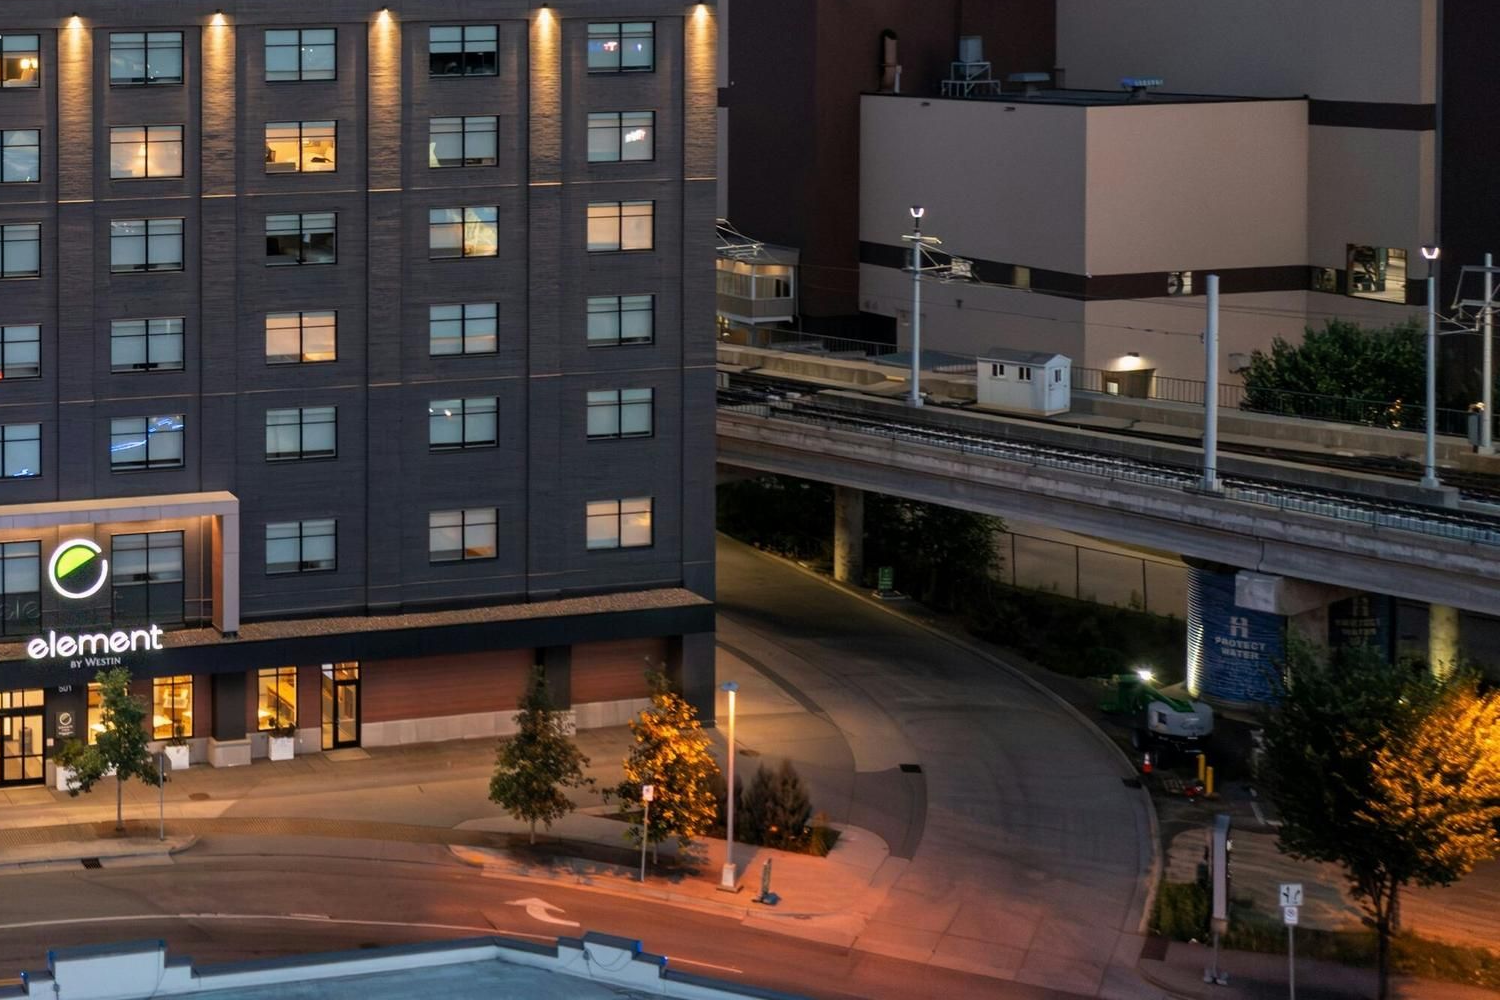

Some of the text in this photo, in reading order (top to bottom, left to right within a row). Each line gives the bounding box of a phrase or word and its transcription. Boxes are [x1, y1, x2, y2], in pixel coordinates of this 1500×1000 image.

[27, 623, 164, 660] element
[1214, 635, 1266, 651] PROTECT
[1220, 646, 1260, 660] WATER
[70, 660, 82, 669] BY
